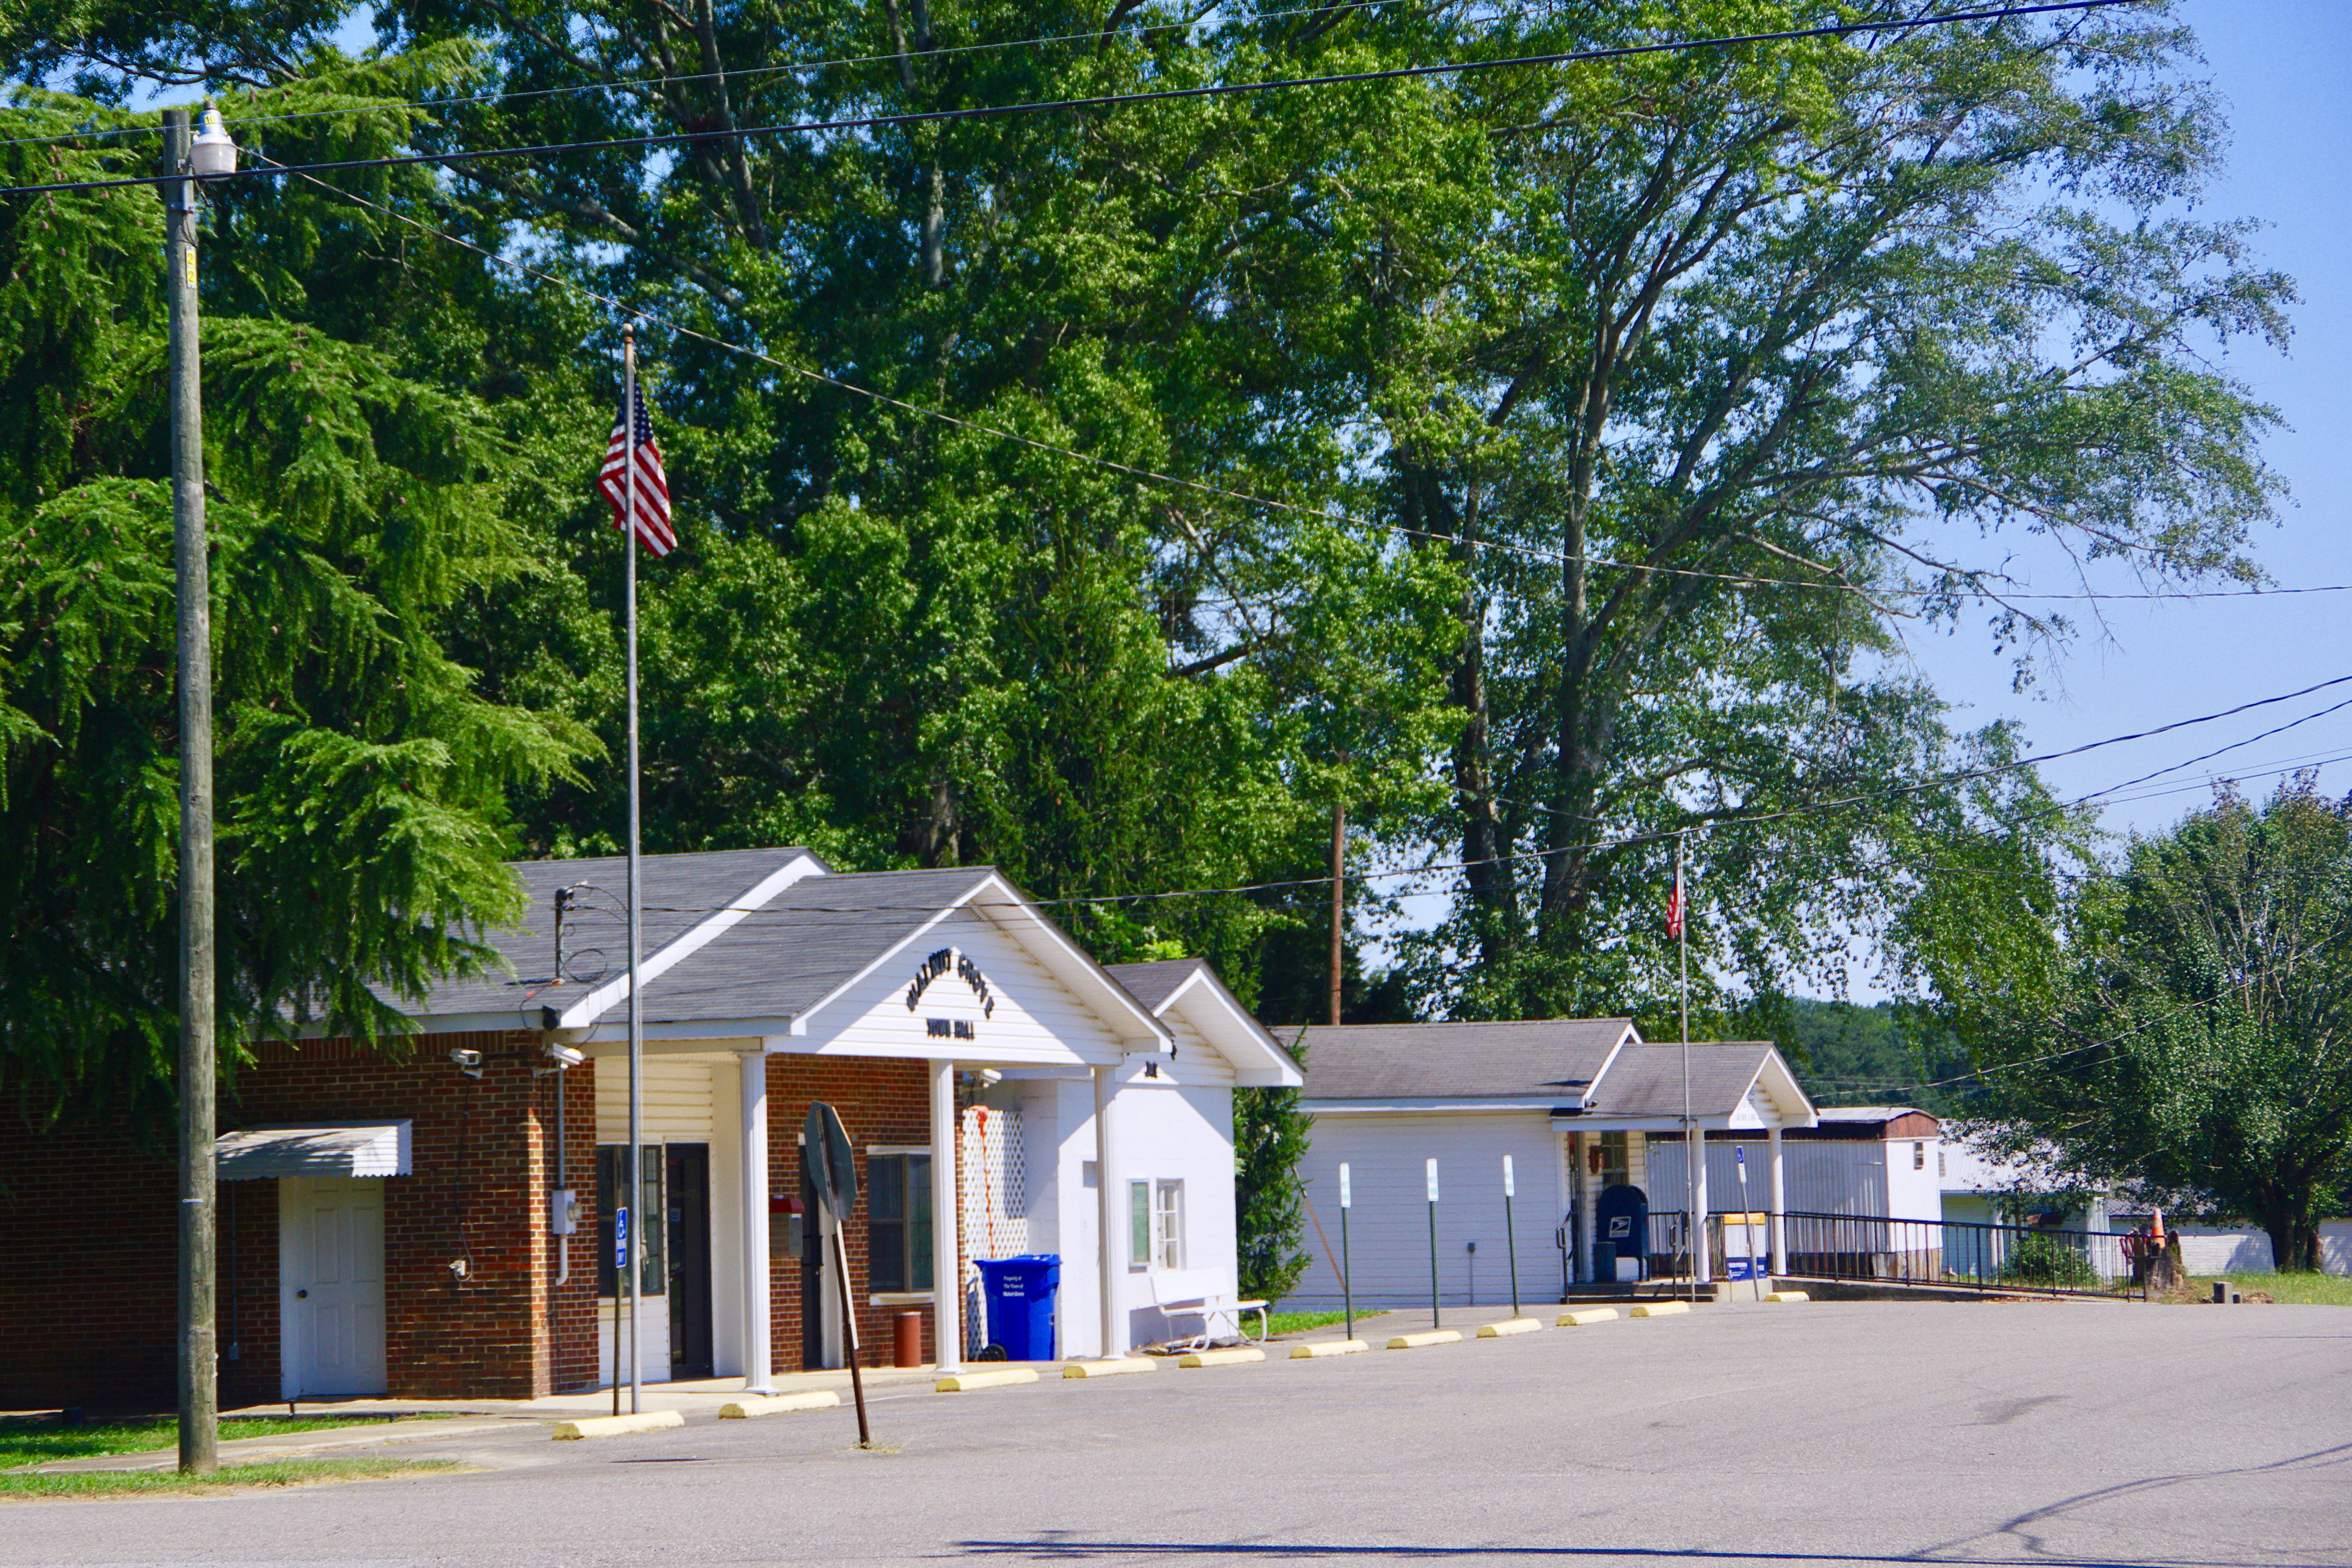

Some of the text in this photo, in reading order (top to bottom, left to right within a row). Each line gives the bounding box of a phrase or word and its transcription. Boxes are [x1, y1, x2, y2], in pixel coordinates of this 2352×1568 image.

[204, 115, 216, 124] 10
[906, 948, 994, 1020] WALNUT GROVE
[926, 1018, 975, 1041] TOWN HALL
